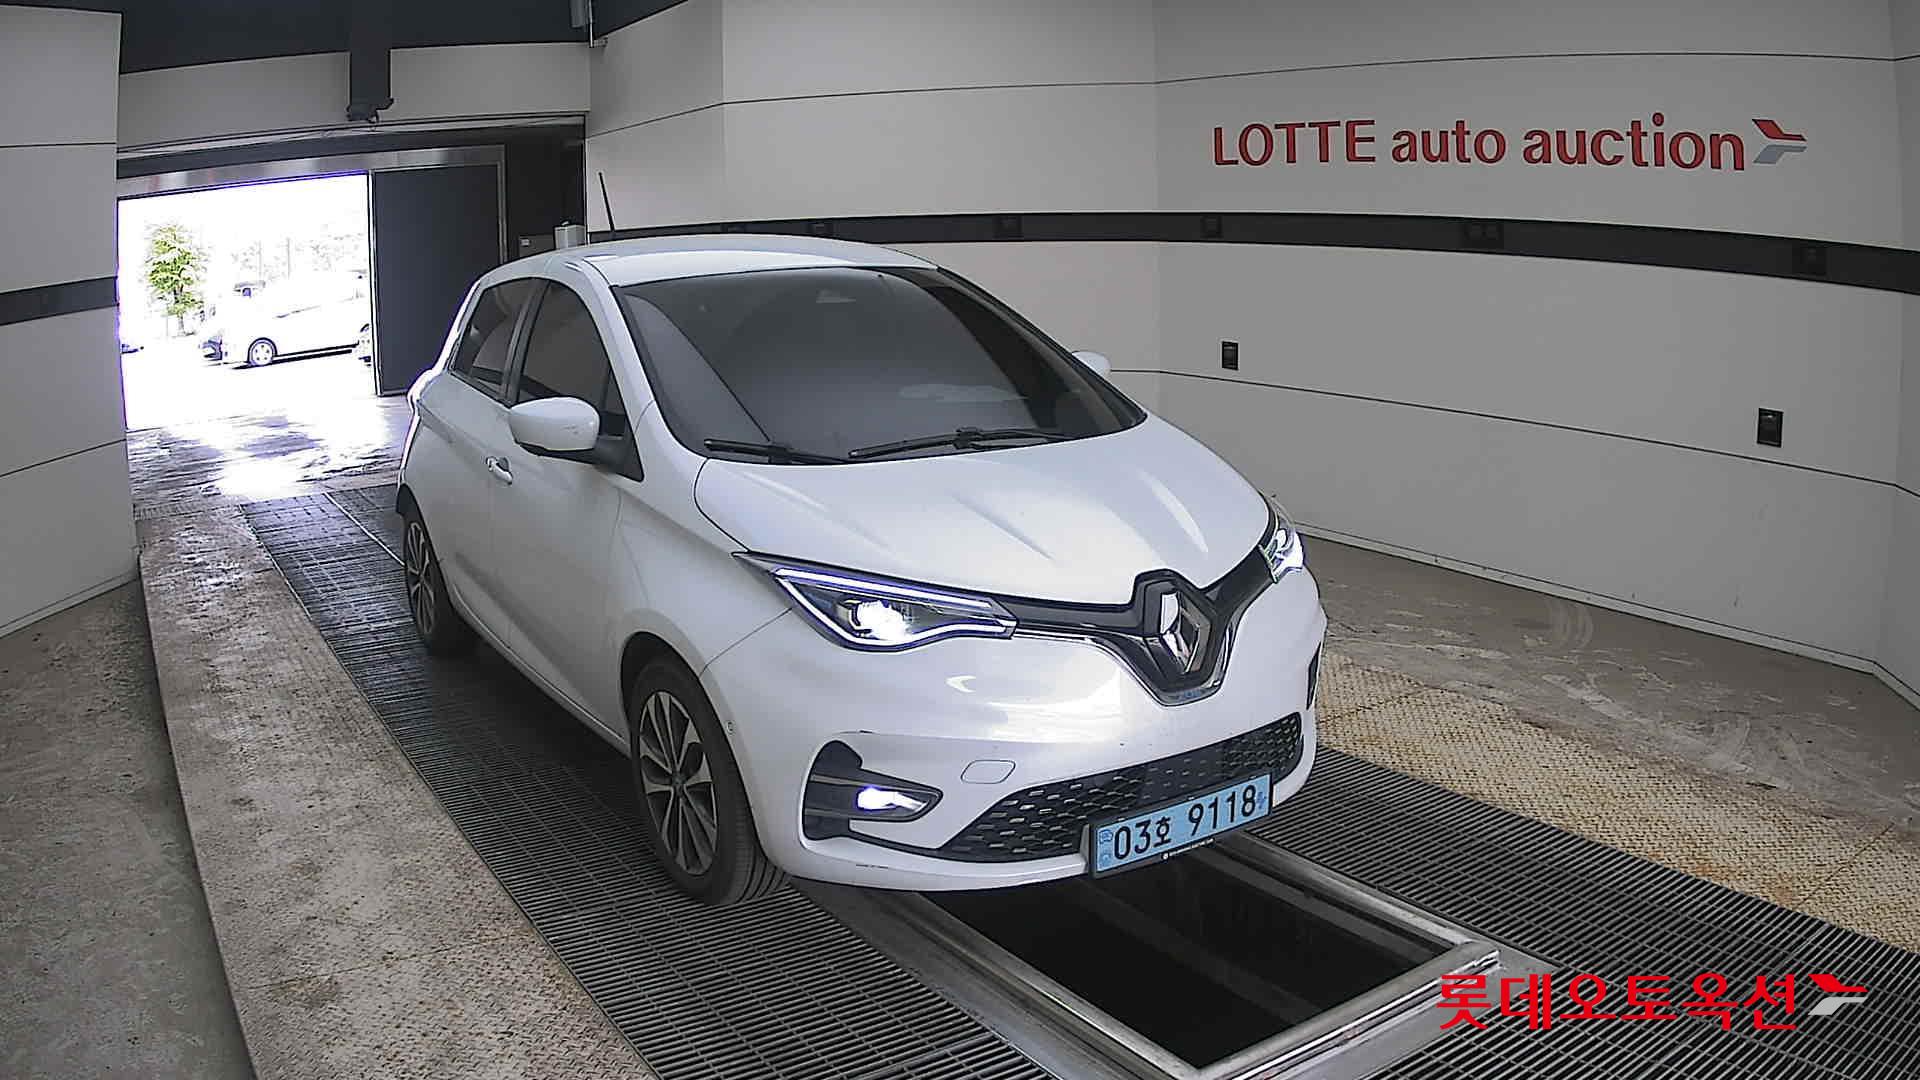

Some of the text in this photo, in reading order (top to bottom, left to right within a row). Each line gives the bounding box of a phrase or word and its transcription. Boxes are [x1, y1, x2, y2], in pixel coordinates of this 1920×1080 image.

[1213, 112, 1745, 171] LOTTE auto auction
[1114, 816, 1172, 860] 03호
[1187, 784, 1257, 837] 9118
